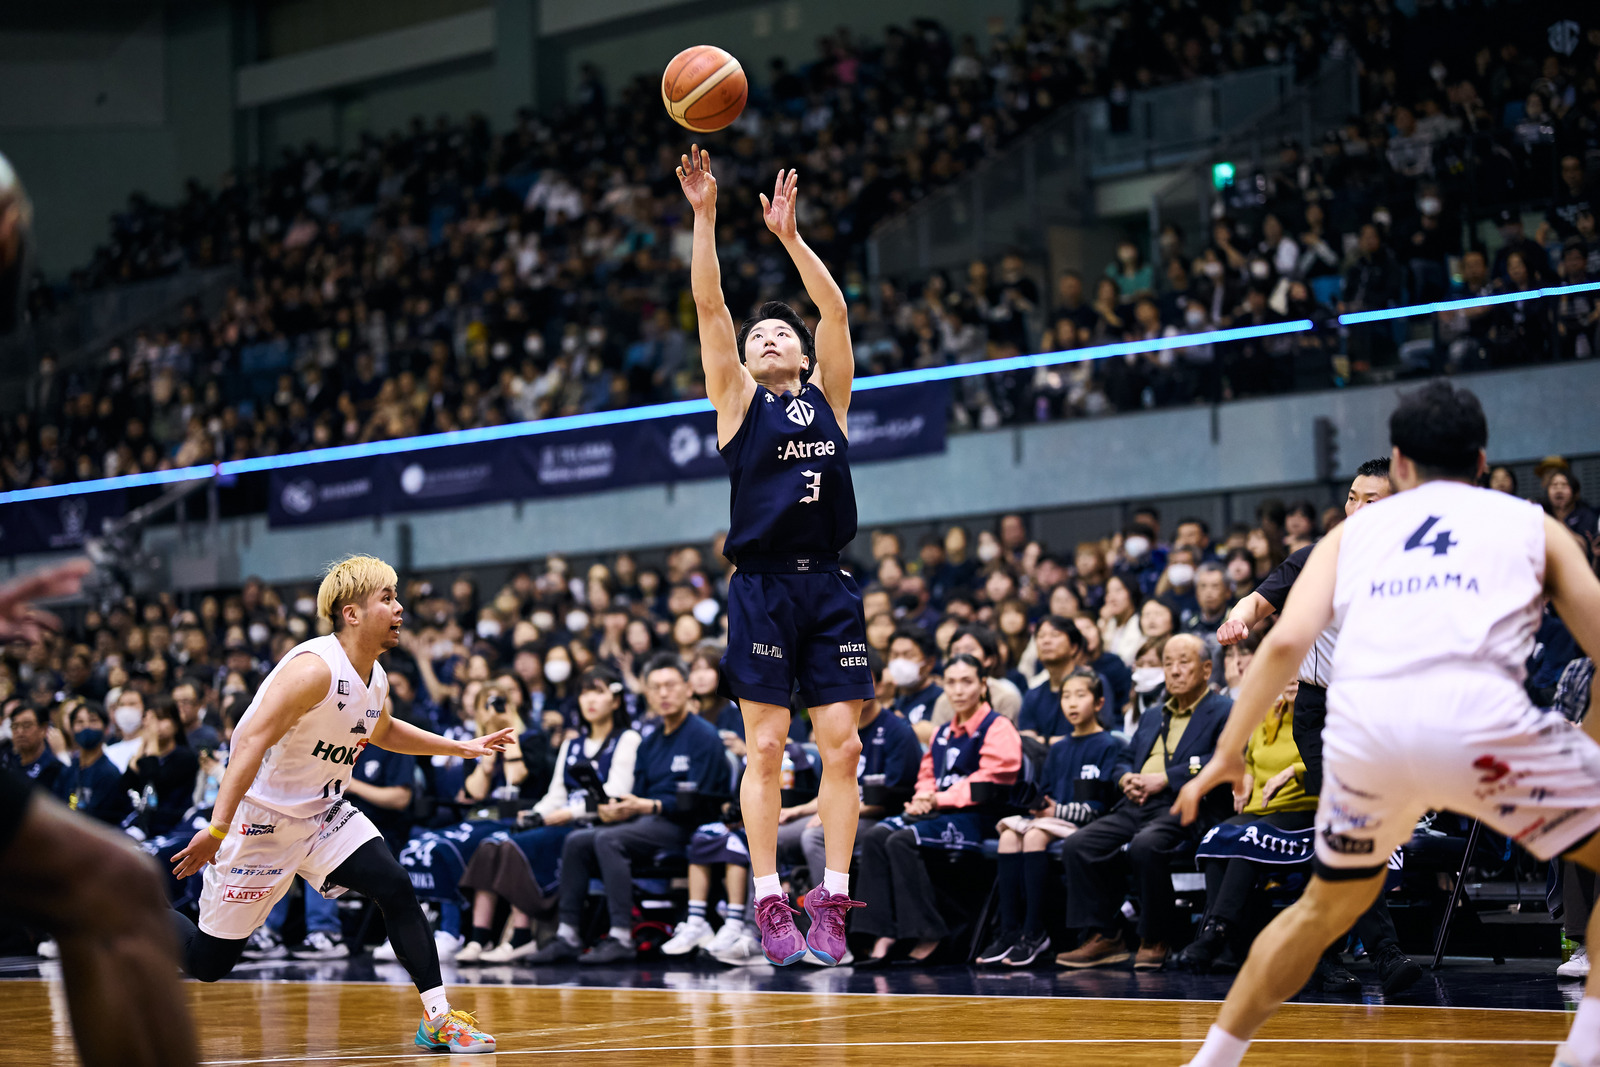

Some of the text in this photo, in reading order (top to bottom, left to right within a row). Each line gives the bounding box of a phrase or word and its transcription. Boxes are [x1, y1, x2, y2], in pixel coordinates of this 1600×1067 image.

[798, 469, 823, 504] 3
[1403, 514, 1460, 556] 4
[1370, 571, 1480, 598] KODAMA
[321, 777, 343, 799] 11
